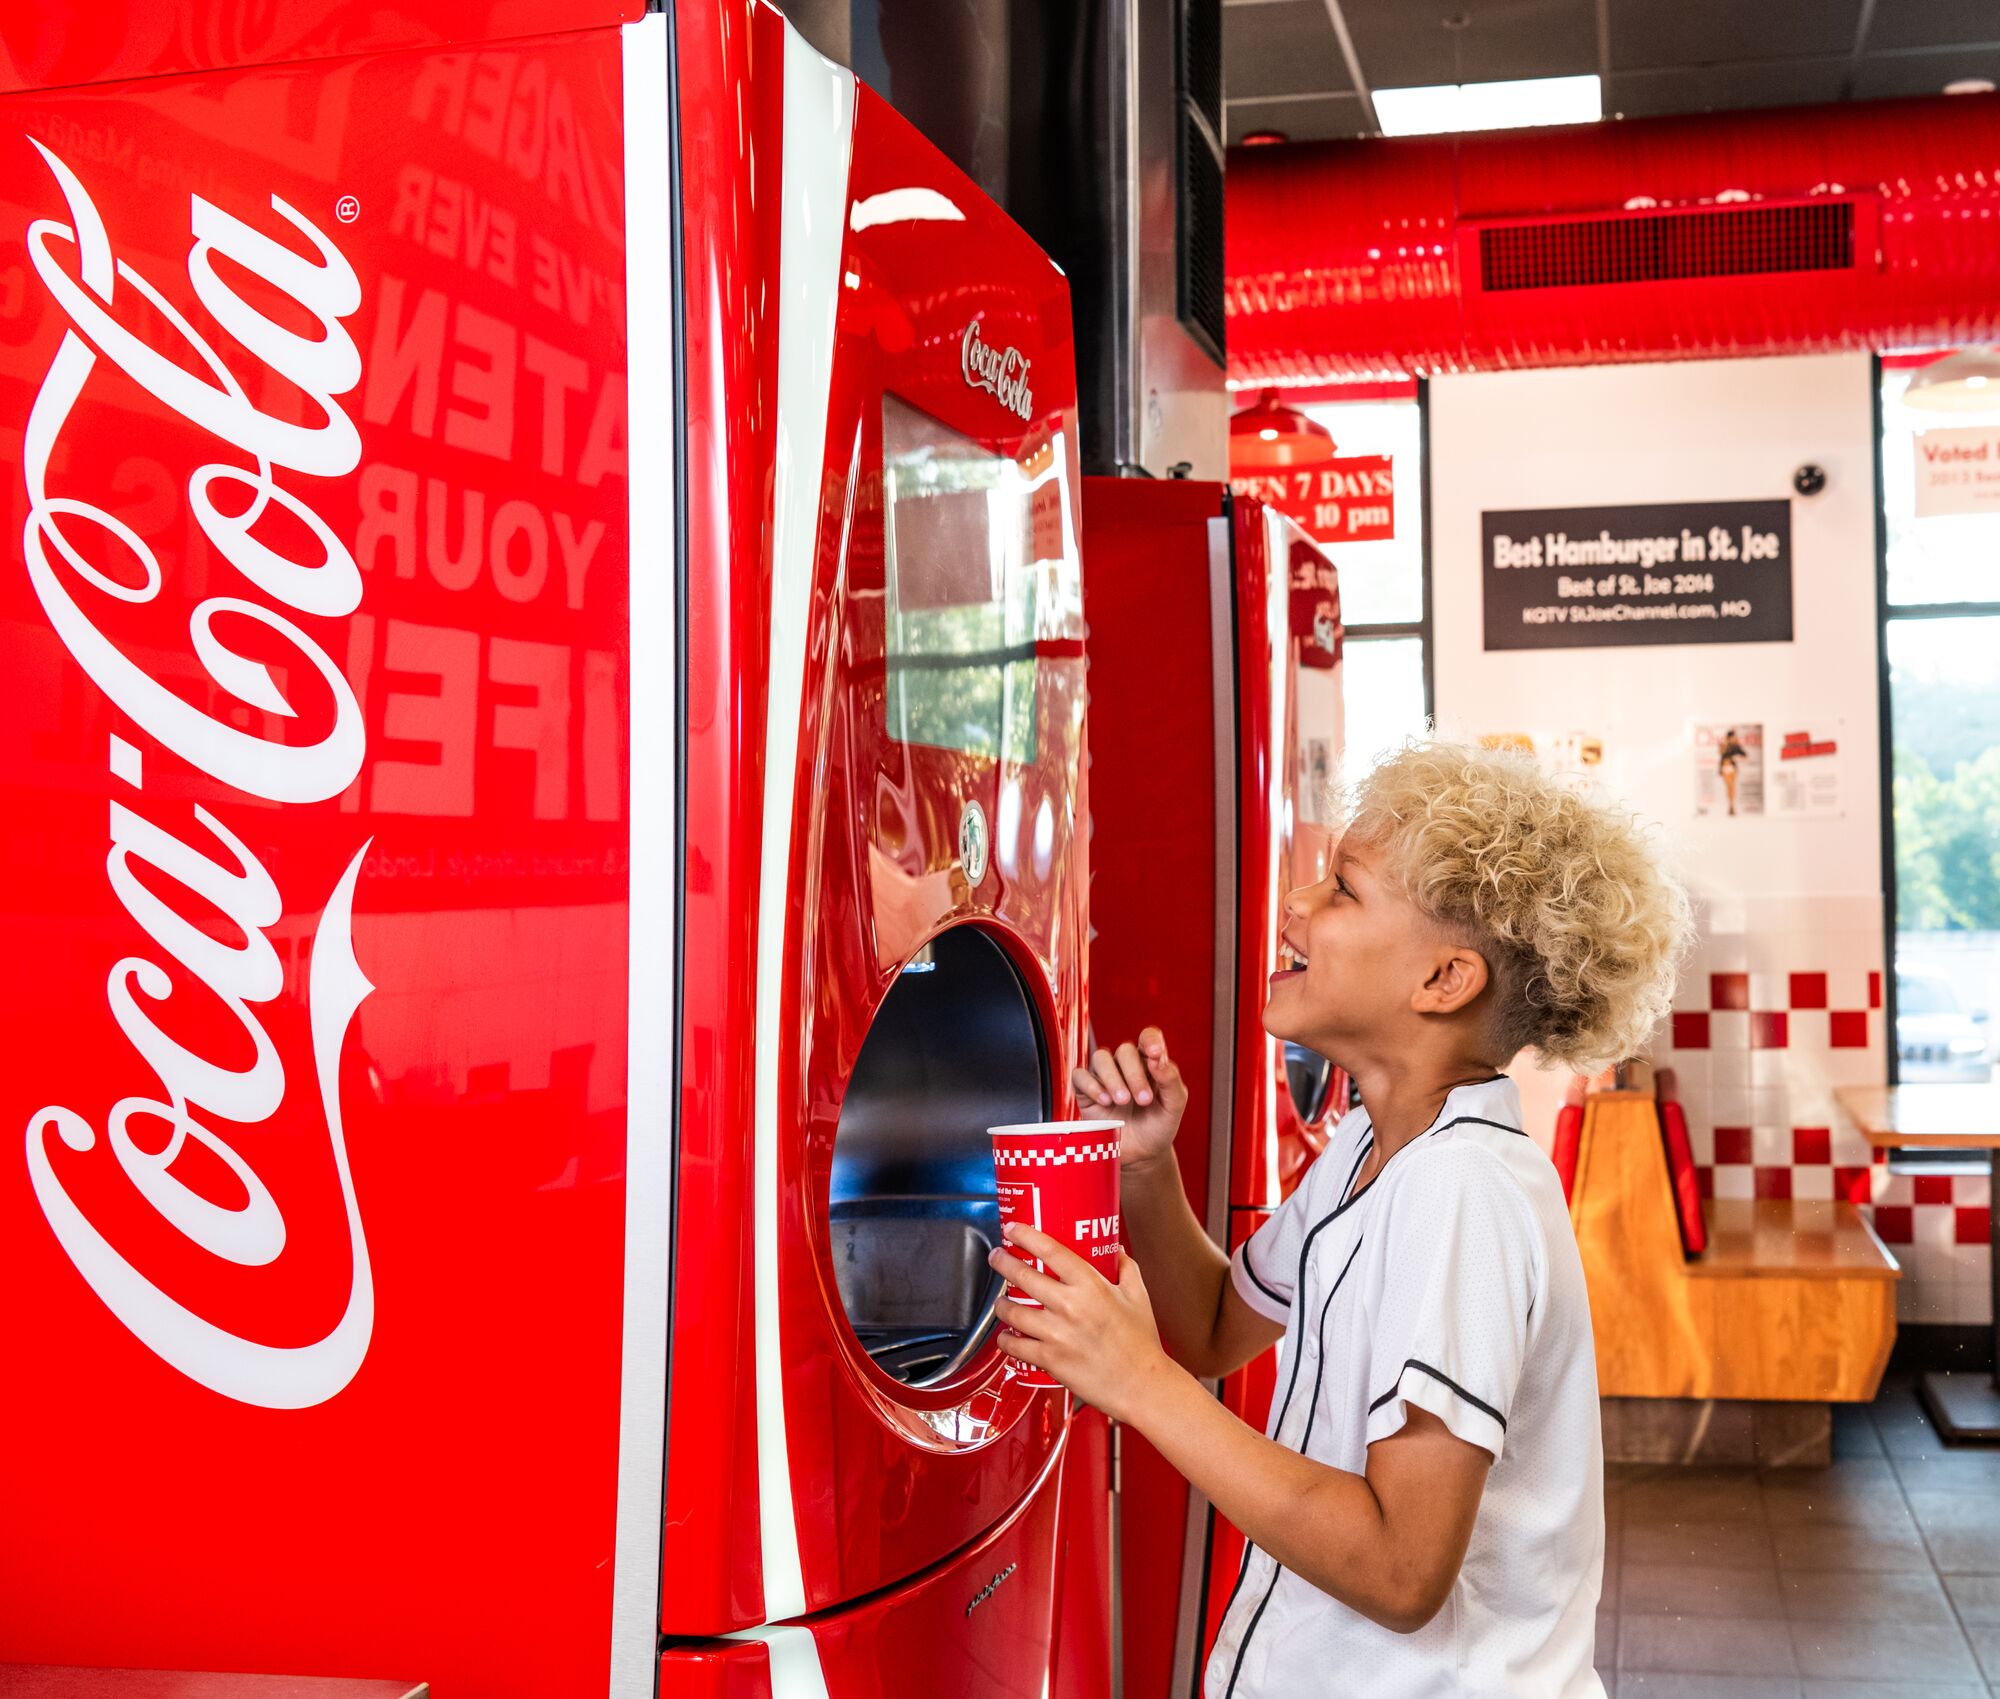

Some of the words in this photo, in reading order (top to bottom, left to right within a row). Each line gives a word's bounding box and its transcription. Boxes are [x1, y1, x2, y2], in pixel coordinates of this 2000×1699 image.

[961, 320, 1033, 421] Coca-Cola
[1923, 441, 1988, 464] Voted
[1230, 475, 1288, 501] PEN
[1294, 472, 1313, 501] 7
[1320, 470, 1393, 499] DAYS
[1314, 502, 1341, 529] 10
[1347, 505, 1390, 534] pm
[1493, 535, 1543, 568] Best
[1545, 530, 1679, 568] Hamburger
[1681, 528, 1705, 561] in
[1708, 526, 1738, 561] St.
[1741, 525, 1780, 563] Joe
[1557, 576, 1595, 598] Best
[1597, 574, 1616, 597] of
[1618, 574, 1641, 596] St.
[1643, 573, 1672, 596] Joe
[25, 134, 376, 1410] Coca-Cola
[1075, 1214, 1120, 1241] FIVE
[1091, 1241, 1120, 1257] BURGE
